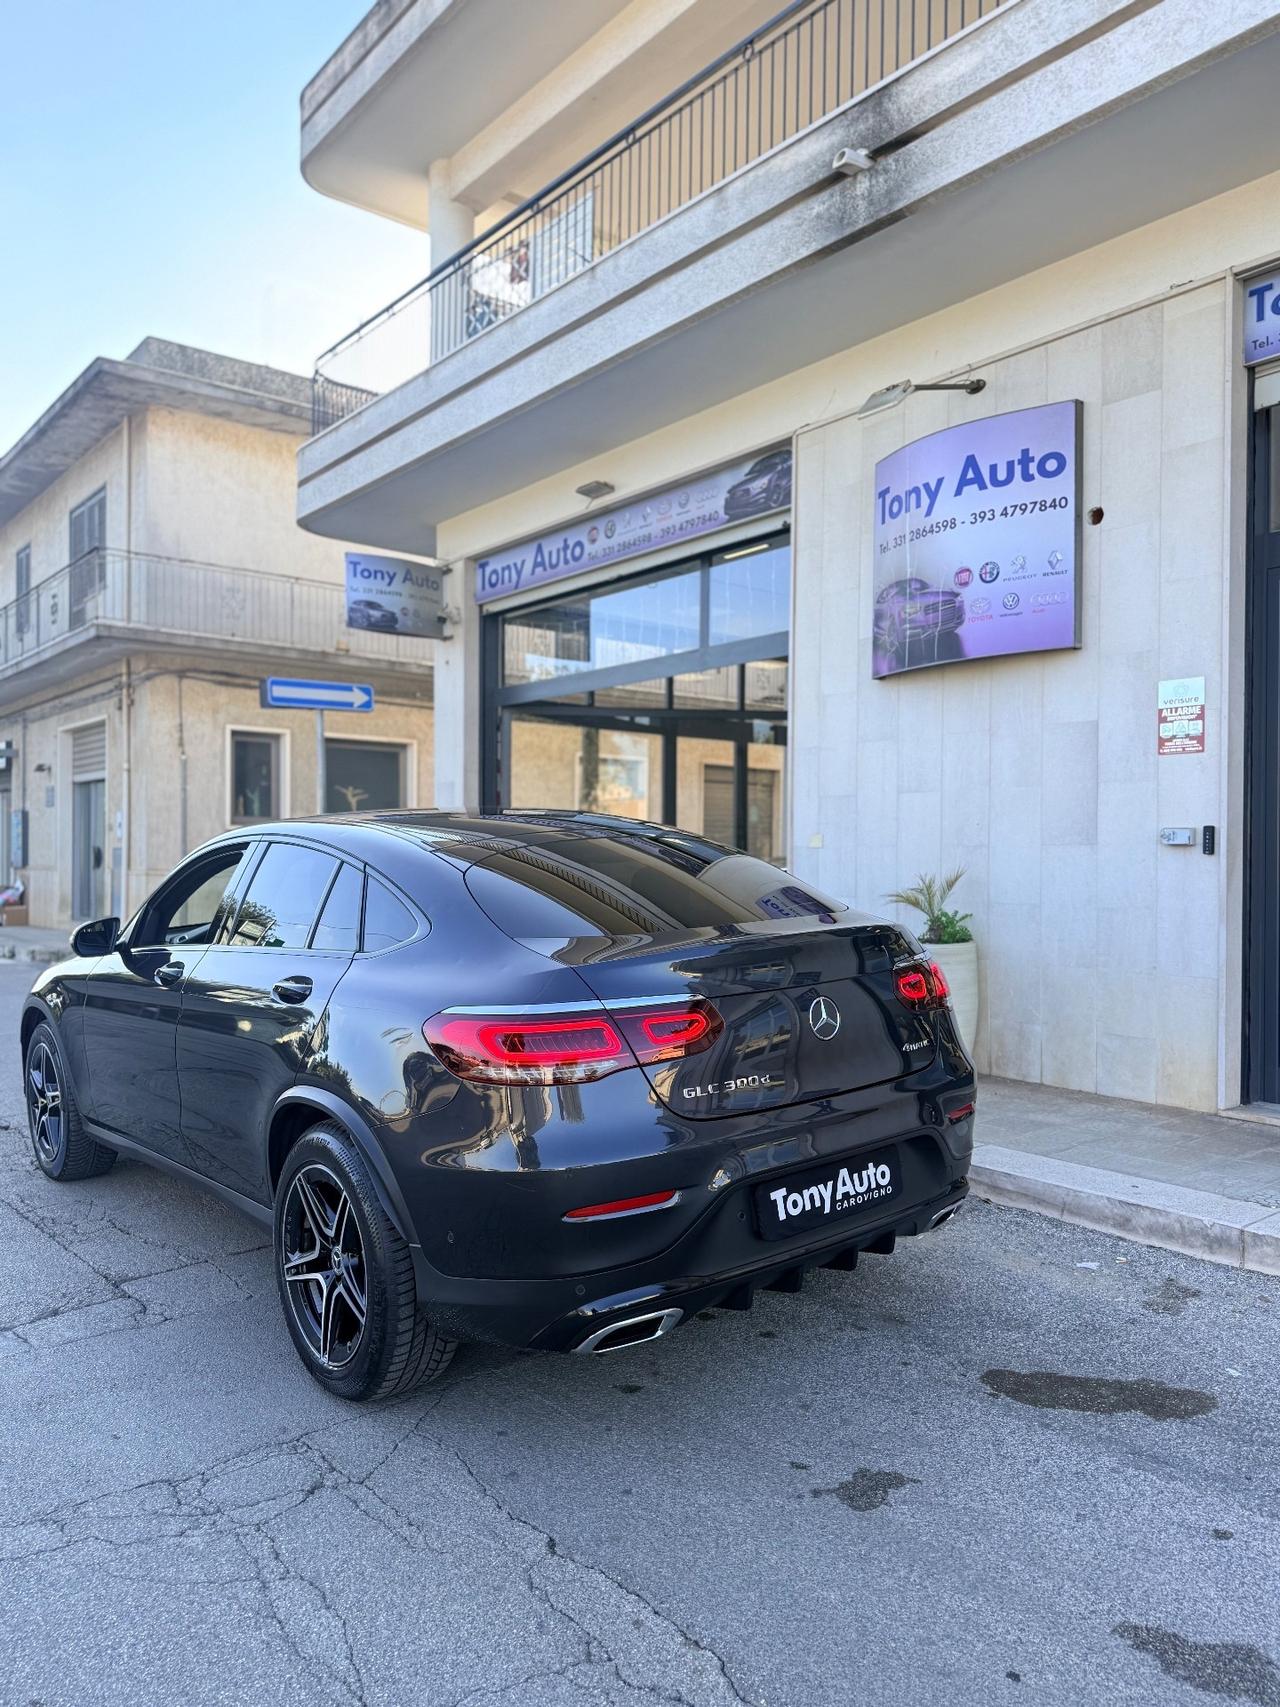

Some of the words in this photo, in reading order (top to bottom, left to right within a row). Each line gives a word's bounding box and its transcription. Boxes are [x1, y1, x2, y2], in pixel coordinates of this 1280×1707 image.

[1251, 336, 1274, 351] Tel.
[877, 476, 945, 525] Tony
[953, 447, 1067, 497] Auto
[660, 525, 677, 538] 393
[892, 534, 908, 549] 331
[909, 517, 957, 542] 2864598
[969, 508, 996, 525] 393
[999, 496, 1069, 519] 4797840
[349, 561, 397, 587] Tony
[402, 568, 440, 591] Auto
[478, 559, 526, 592] Tony
[529, 538, 585, 576] Auto
[1162, 706, 1201, 717] ALLARME
[683, 1083, 720, 1098] GLC
[836, 1186, 893, 1211] CAROVIGNO
